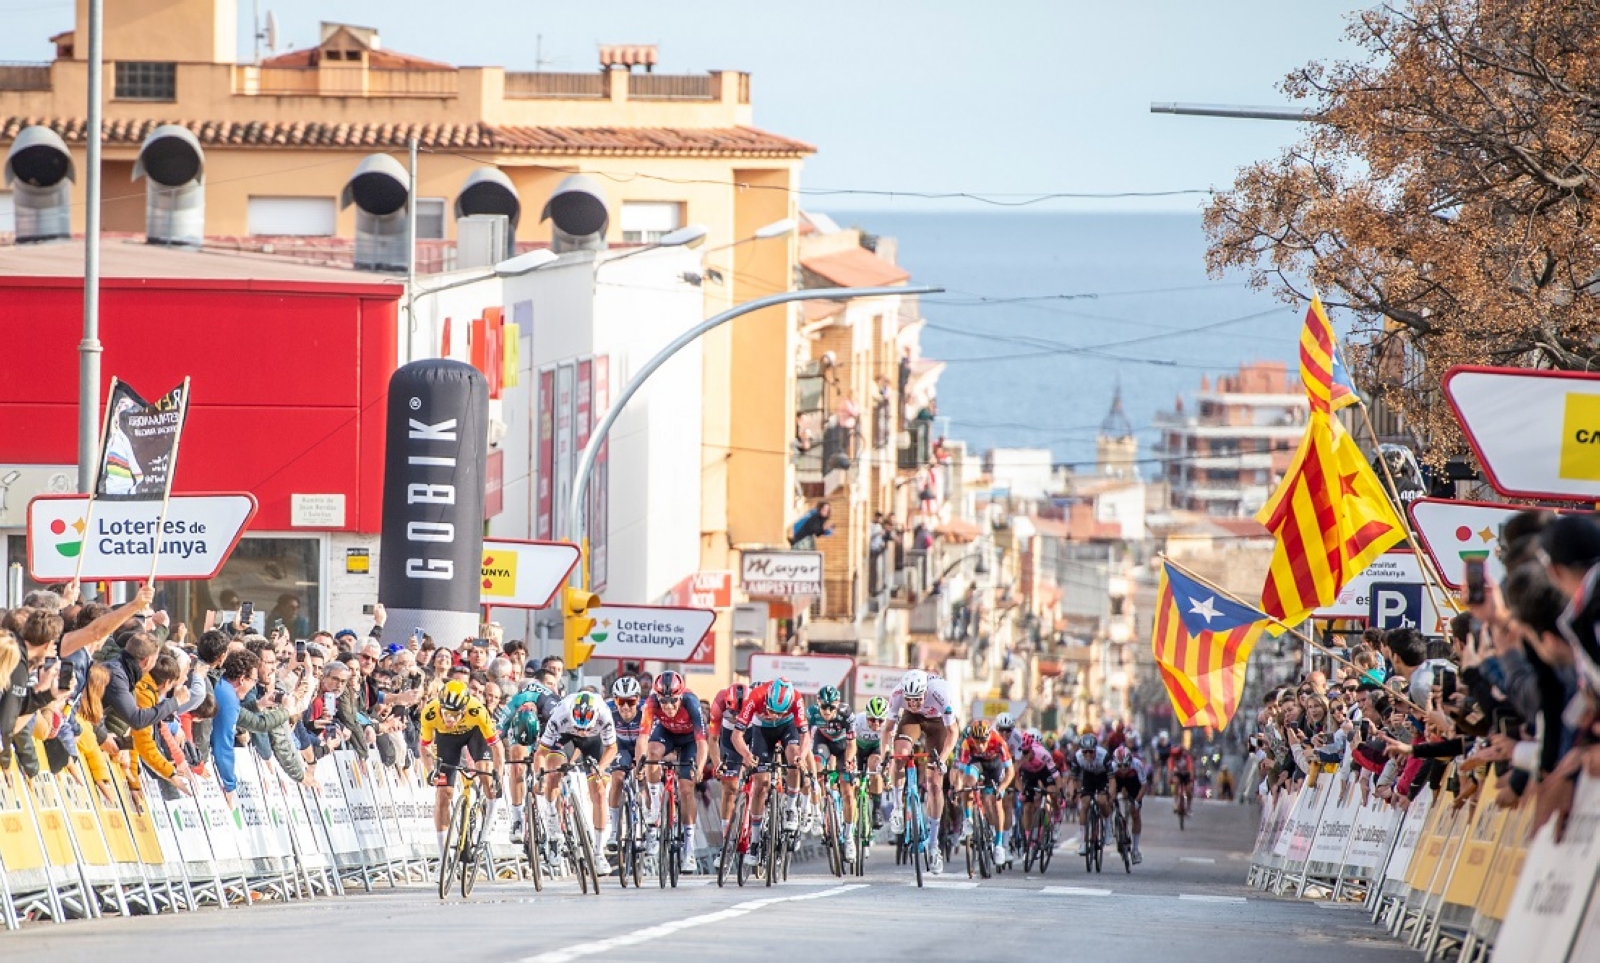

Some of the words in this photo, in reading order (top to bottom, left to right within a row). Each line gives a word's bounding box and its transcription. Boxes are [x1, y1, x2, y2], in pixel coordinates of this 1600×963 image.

[406, 417, 458, 581] GOBIK
[99, 515, 186, 535] Loteries
[189, 521, 207, 534] de
[98, 537, 207, 559] Catalunya
[481, 568, 511, 578] UNYA
[747, 557, 819, 577] Mayor
[1366, 569, 1406, 578] Catalunya
[1377, 590, 1408, 628] P
[617, 619, 672, 632] Loteries
[673, 625, 685, 633] de
[617, 631, 685, 648] Catalunya
